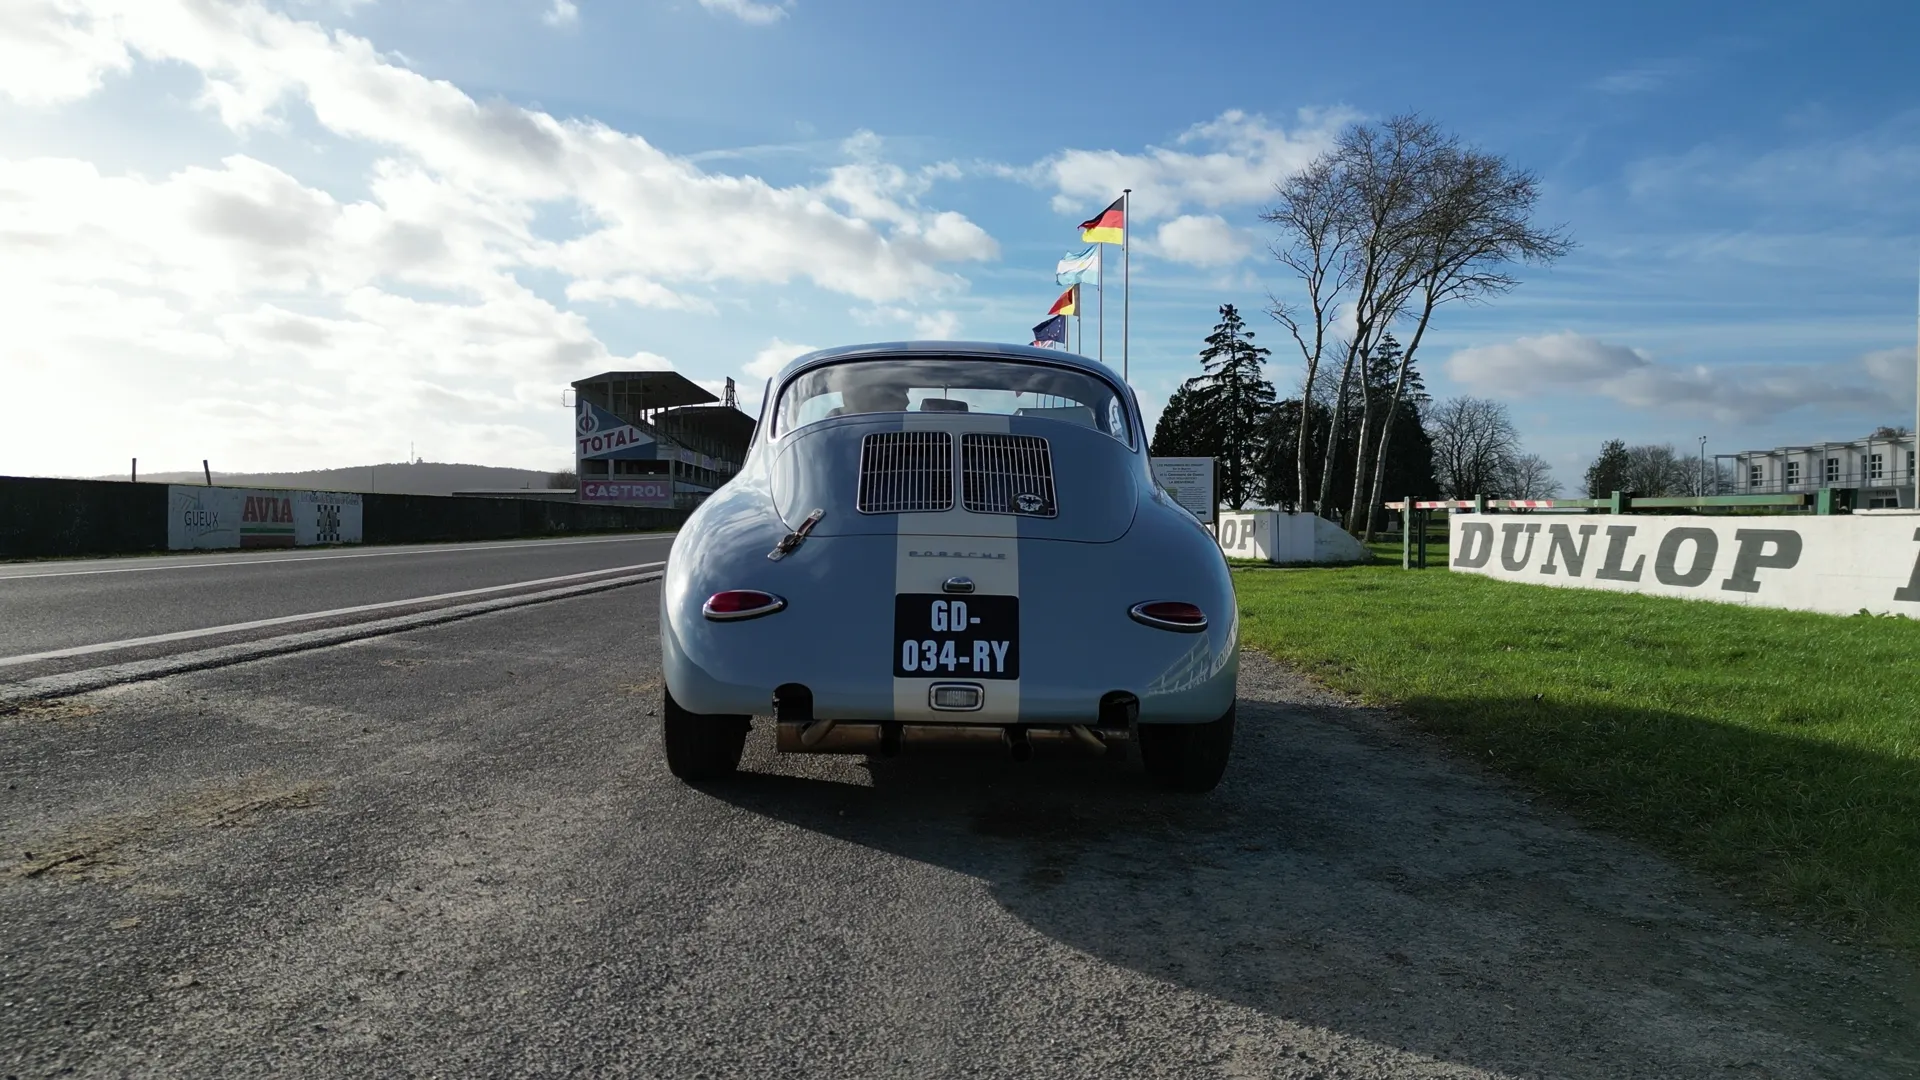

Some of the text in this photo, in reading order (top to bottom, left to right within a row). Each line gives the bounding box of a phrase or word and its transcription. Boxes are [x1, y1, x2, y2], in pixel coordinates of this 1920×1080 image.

[579, 428, 640, 455] TOTAL
[585, 485, 665, 498] CASTROL
[184, 510, 219, 526] GUEUX
[242, 496, 294, 522] AVIA
[909, 551, 1006, 560] PORSCHE
[1453, 522, 1803, 594] DUNLOP
[931, 600, 981, 632] GD-
[902, 639, 1010, 673] 034-RY
